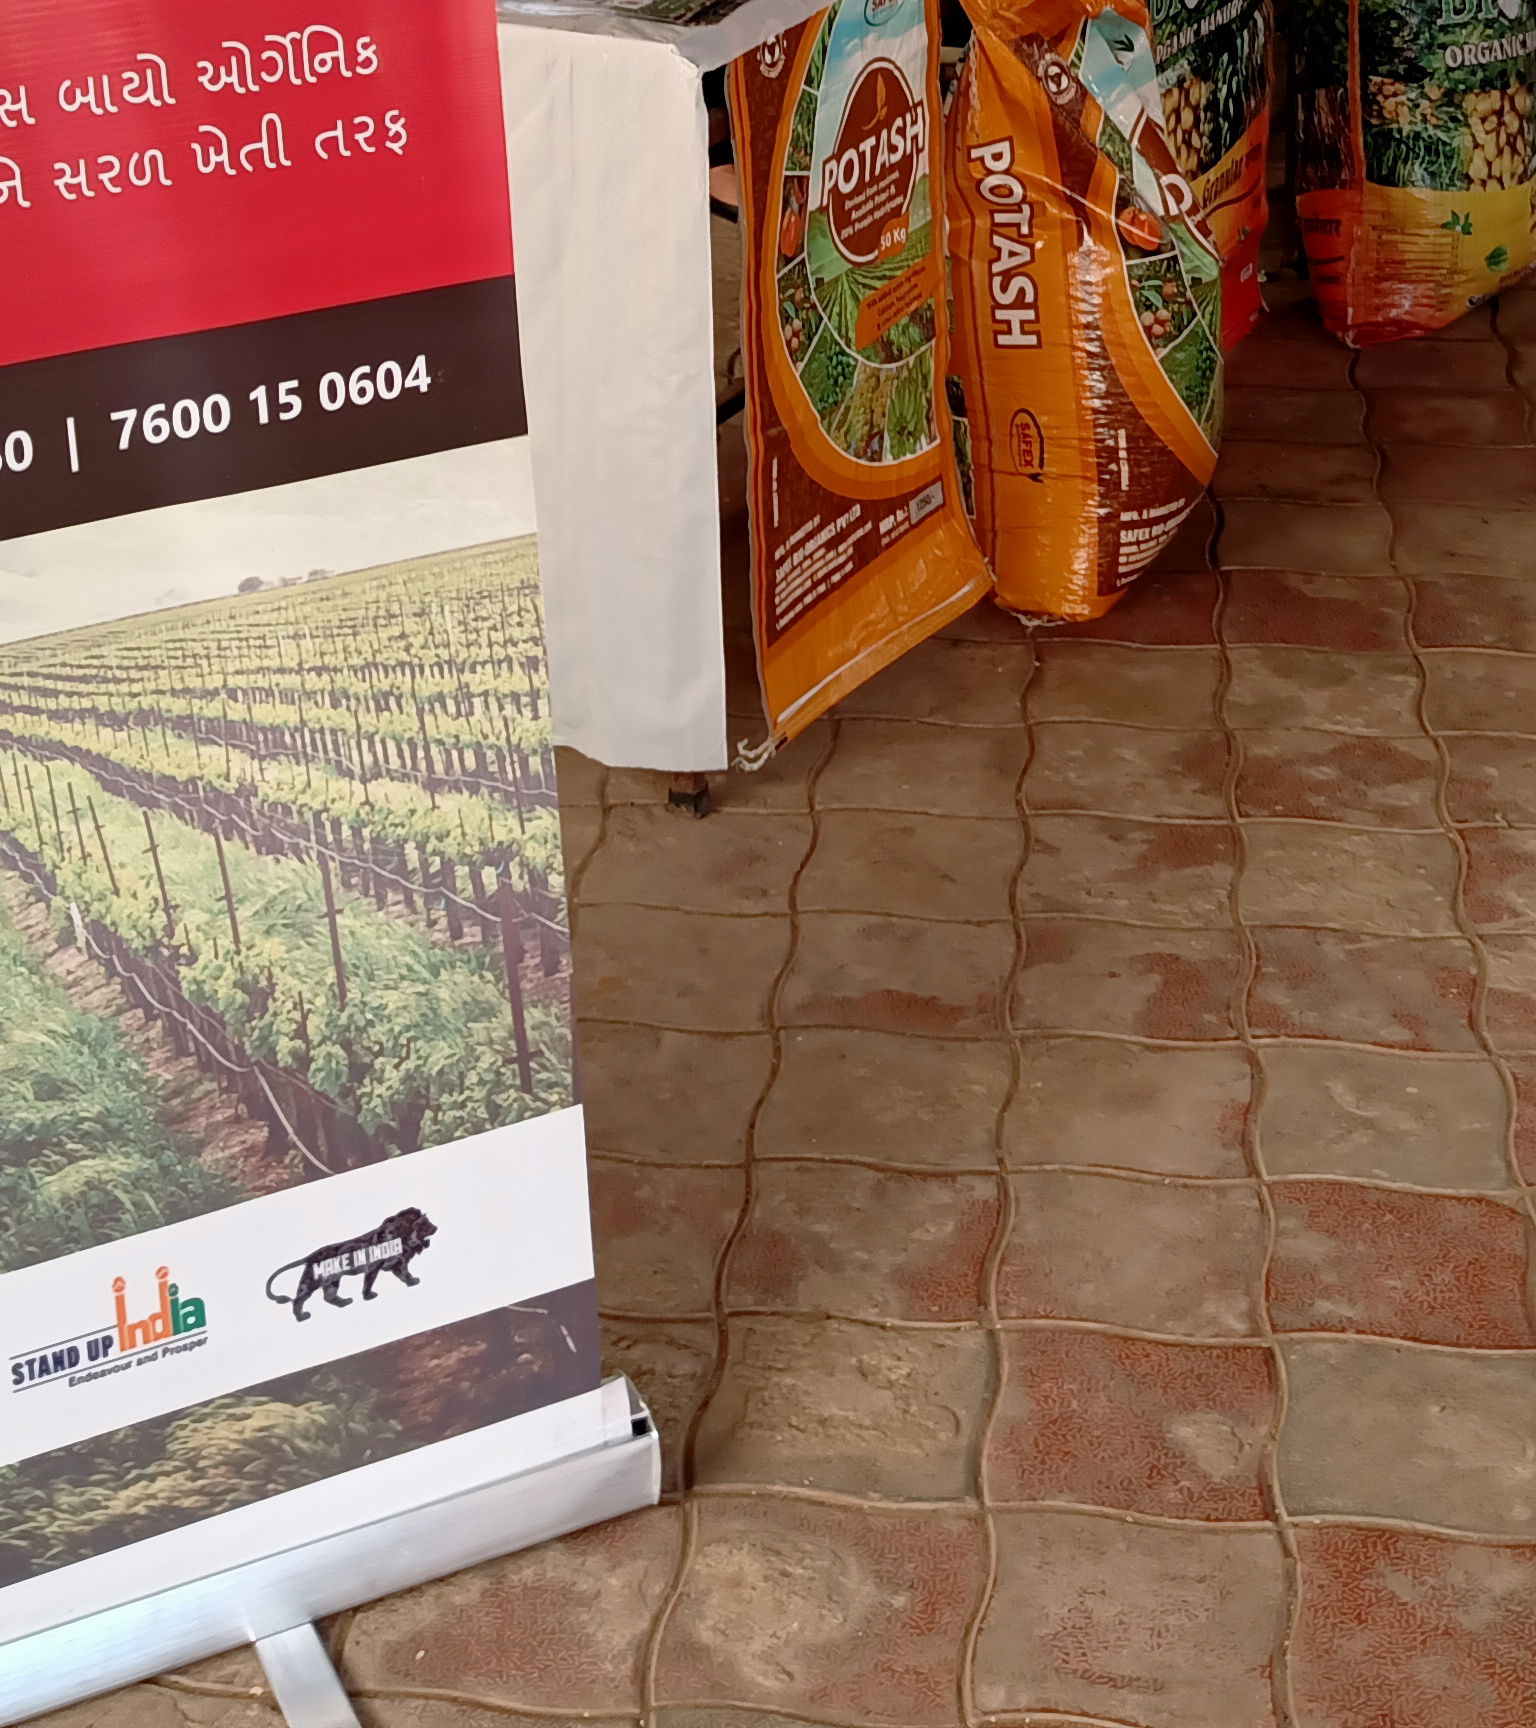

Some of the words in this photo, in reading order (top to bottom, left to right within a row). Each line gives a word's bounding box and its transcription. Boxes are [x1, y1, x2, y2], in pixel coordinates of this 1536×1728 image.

[1155, 22, 1199, 66] RGANIC
[1444, 34, 1526, 69] ORGANIC
[58, 52, 177, 117] બાયો
[53, 148, 173, 204] સરળ
[190, 112, 293, 179] ખેતી
[314, 108, 410, 163] તરફ
[822, 104, 924, 207] POTASH
[880, 231, 892, 251] 50
[970, 139, 1039, 347] POTASH
[110, 392, 231, 452] 7600
[247, 378, 303, 426] 15
[318, 353, 433, 413] 0604
[1018, 422, 1036, 471] SAFEX
[313, 1253, 351, 1280] MAKE
[353, 1247, 367, 1267] IN
[369, 1237, 403, 1264] INDIA
[10, 1345, 81, 1386] STAND
[86, 1334, 114, 1362] UP
[68, 1359, 134, 1388] Endeavour
[136, 1351, 159, 1367] and
[161, 1336, 208, 1360] Prosper
